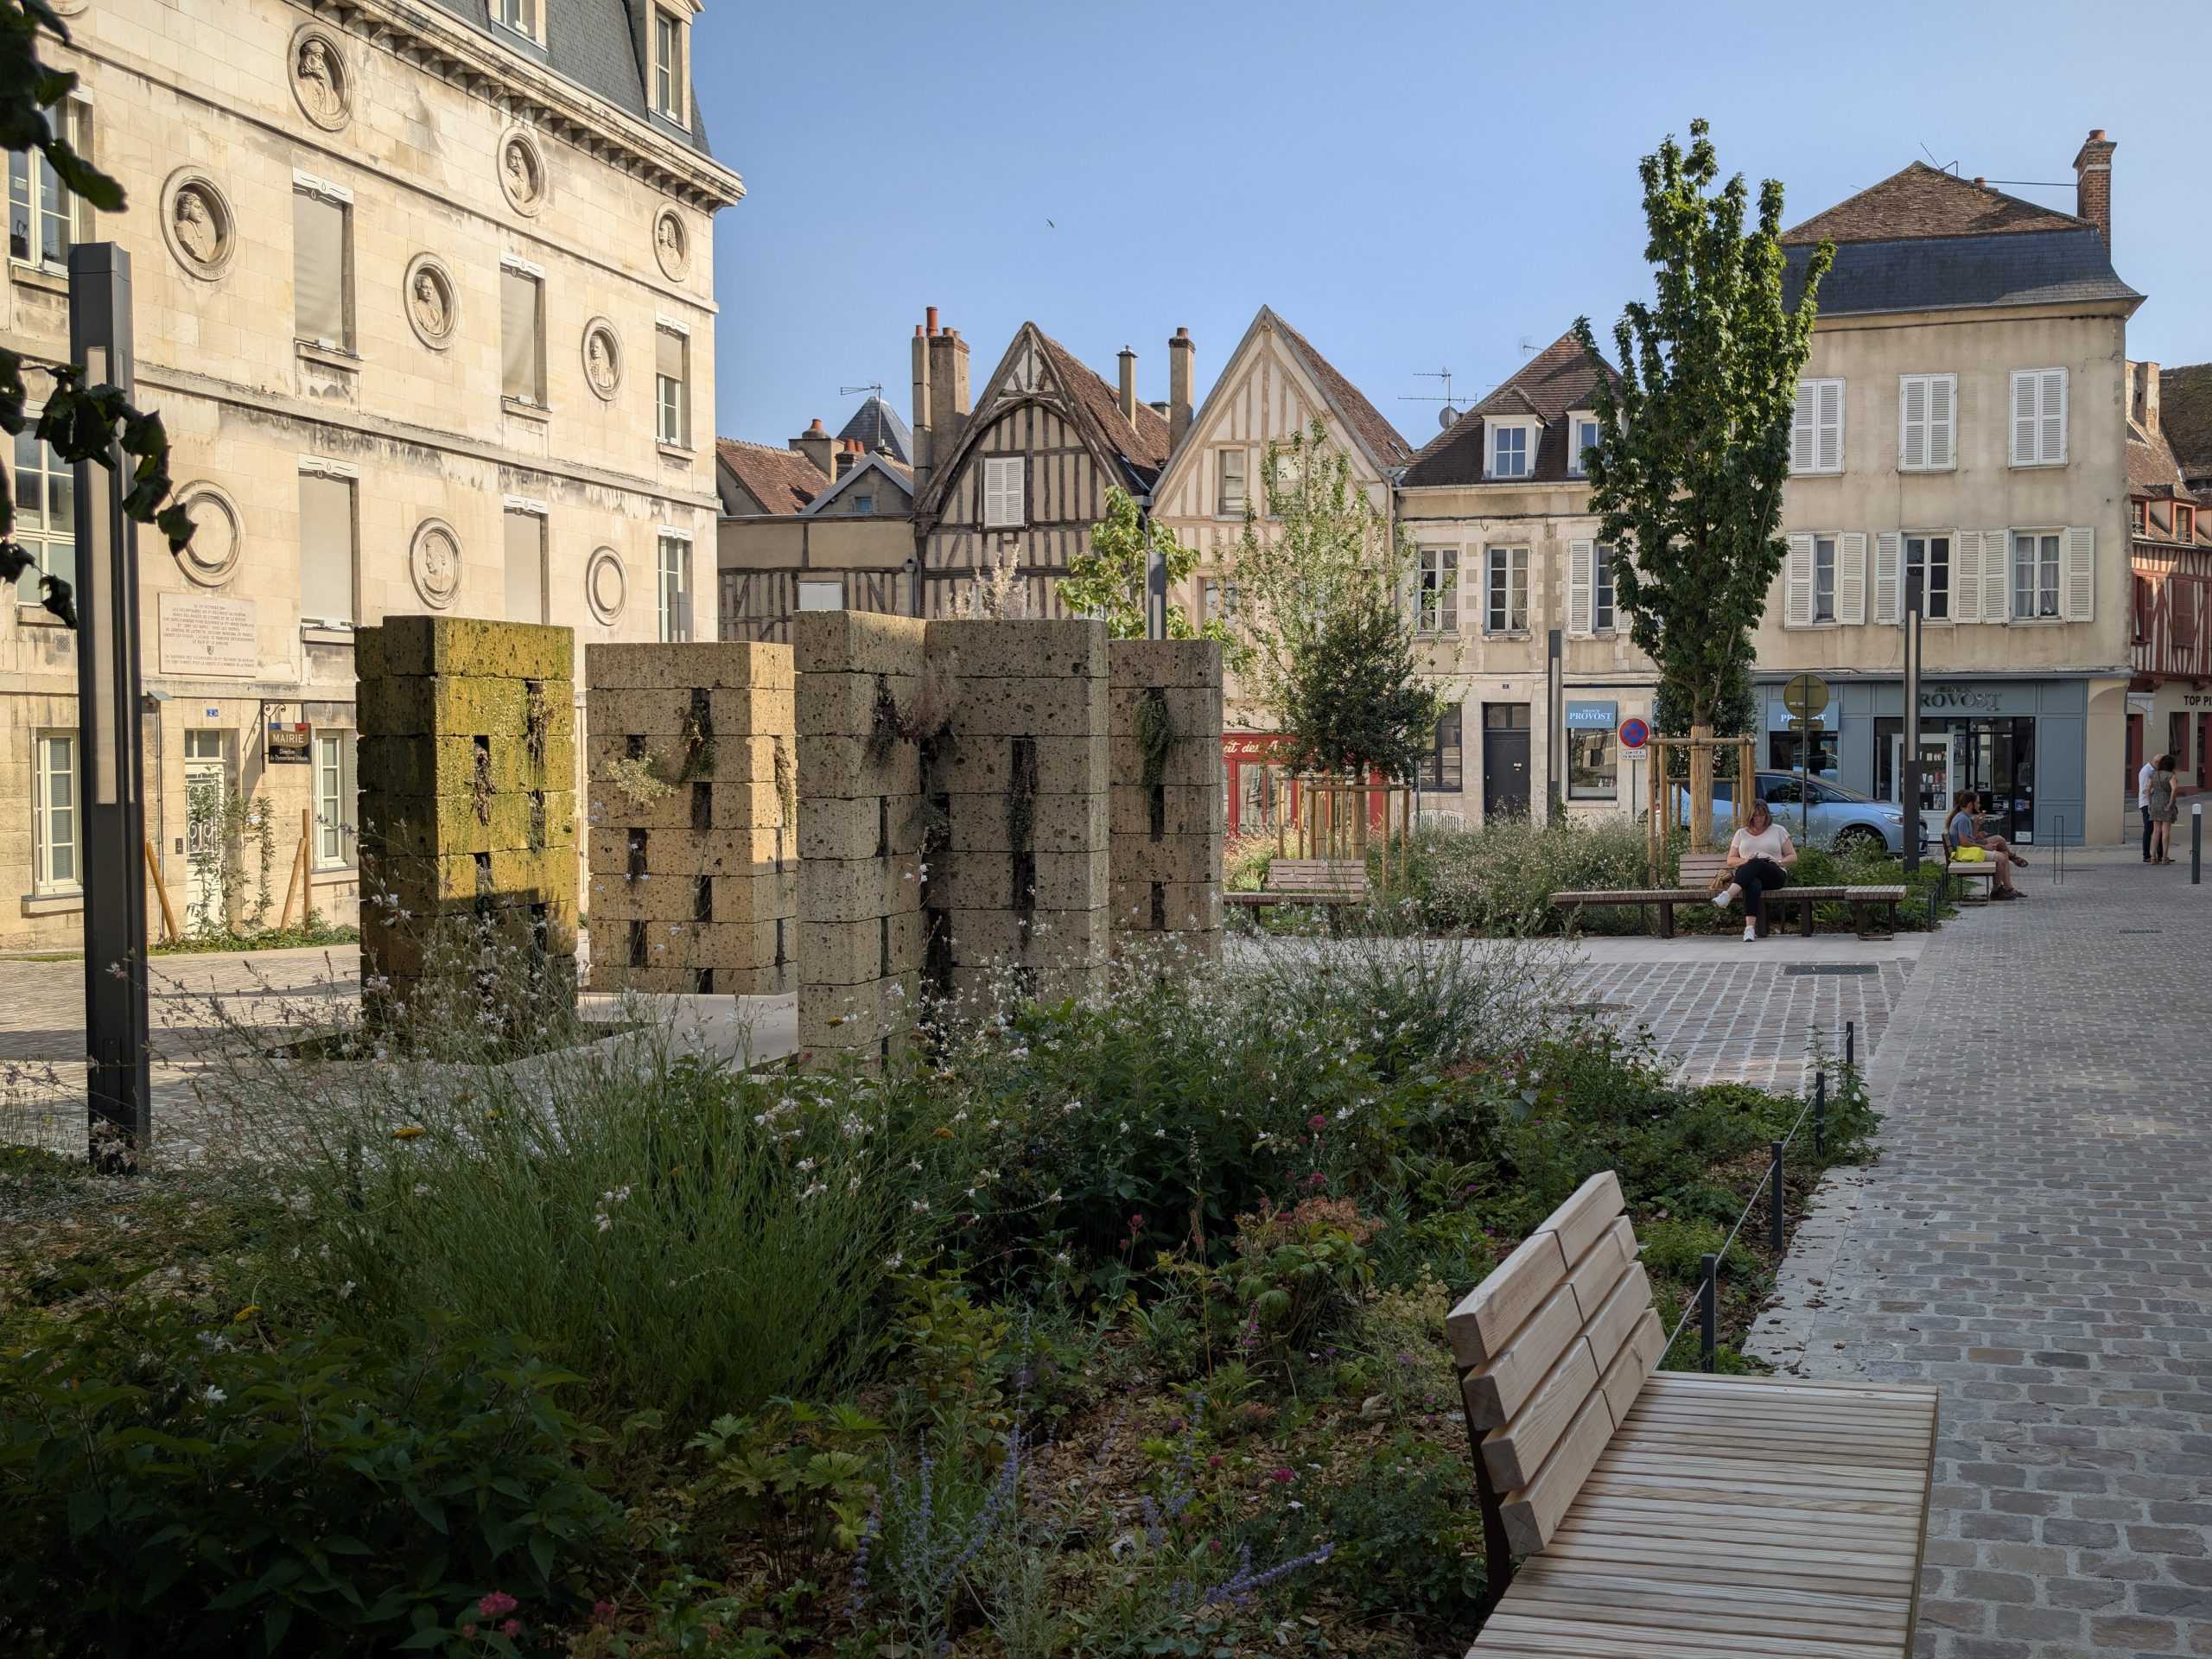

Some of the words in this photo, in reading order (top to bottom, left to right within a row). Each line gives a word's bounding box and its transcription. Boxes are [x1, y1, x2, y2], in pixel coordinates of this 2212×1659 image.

[1920, 692, 2001, 708] ROVOST
[2184, 696, 2201, 705] TOP
[272, 734, 304, 744] MAIRIE
